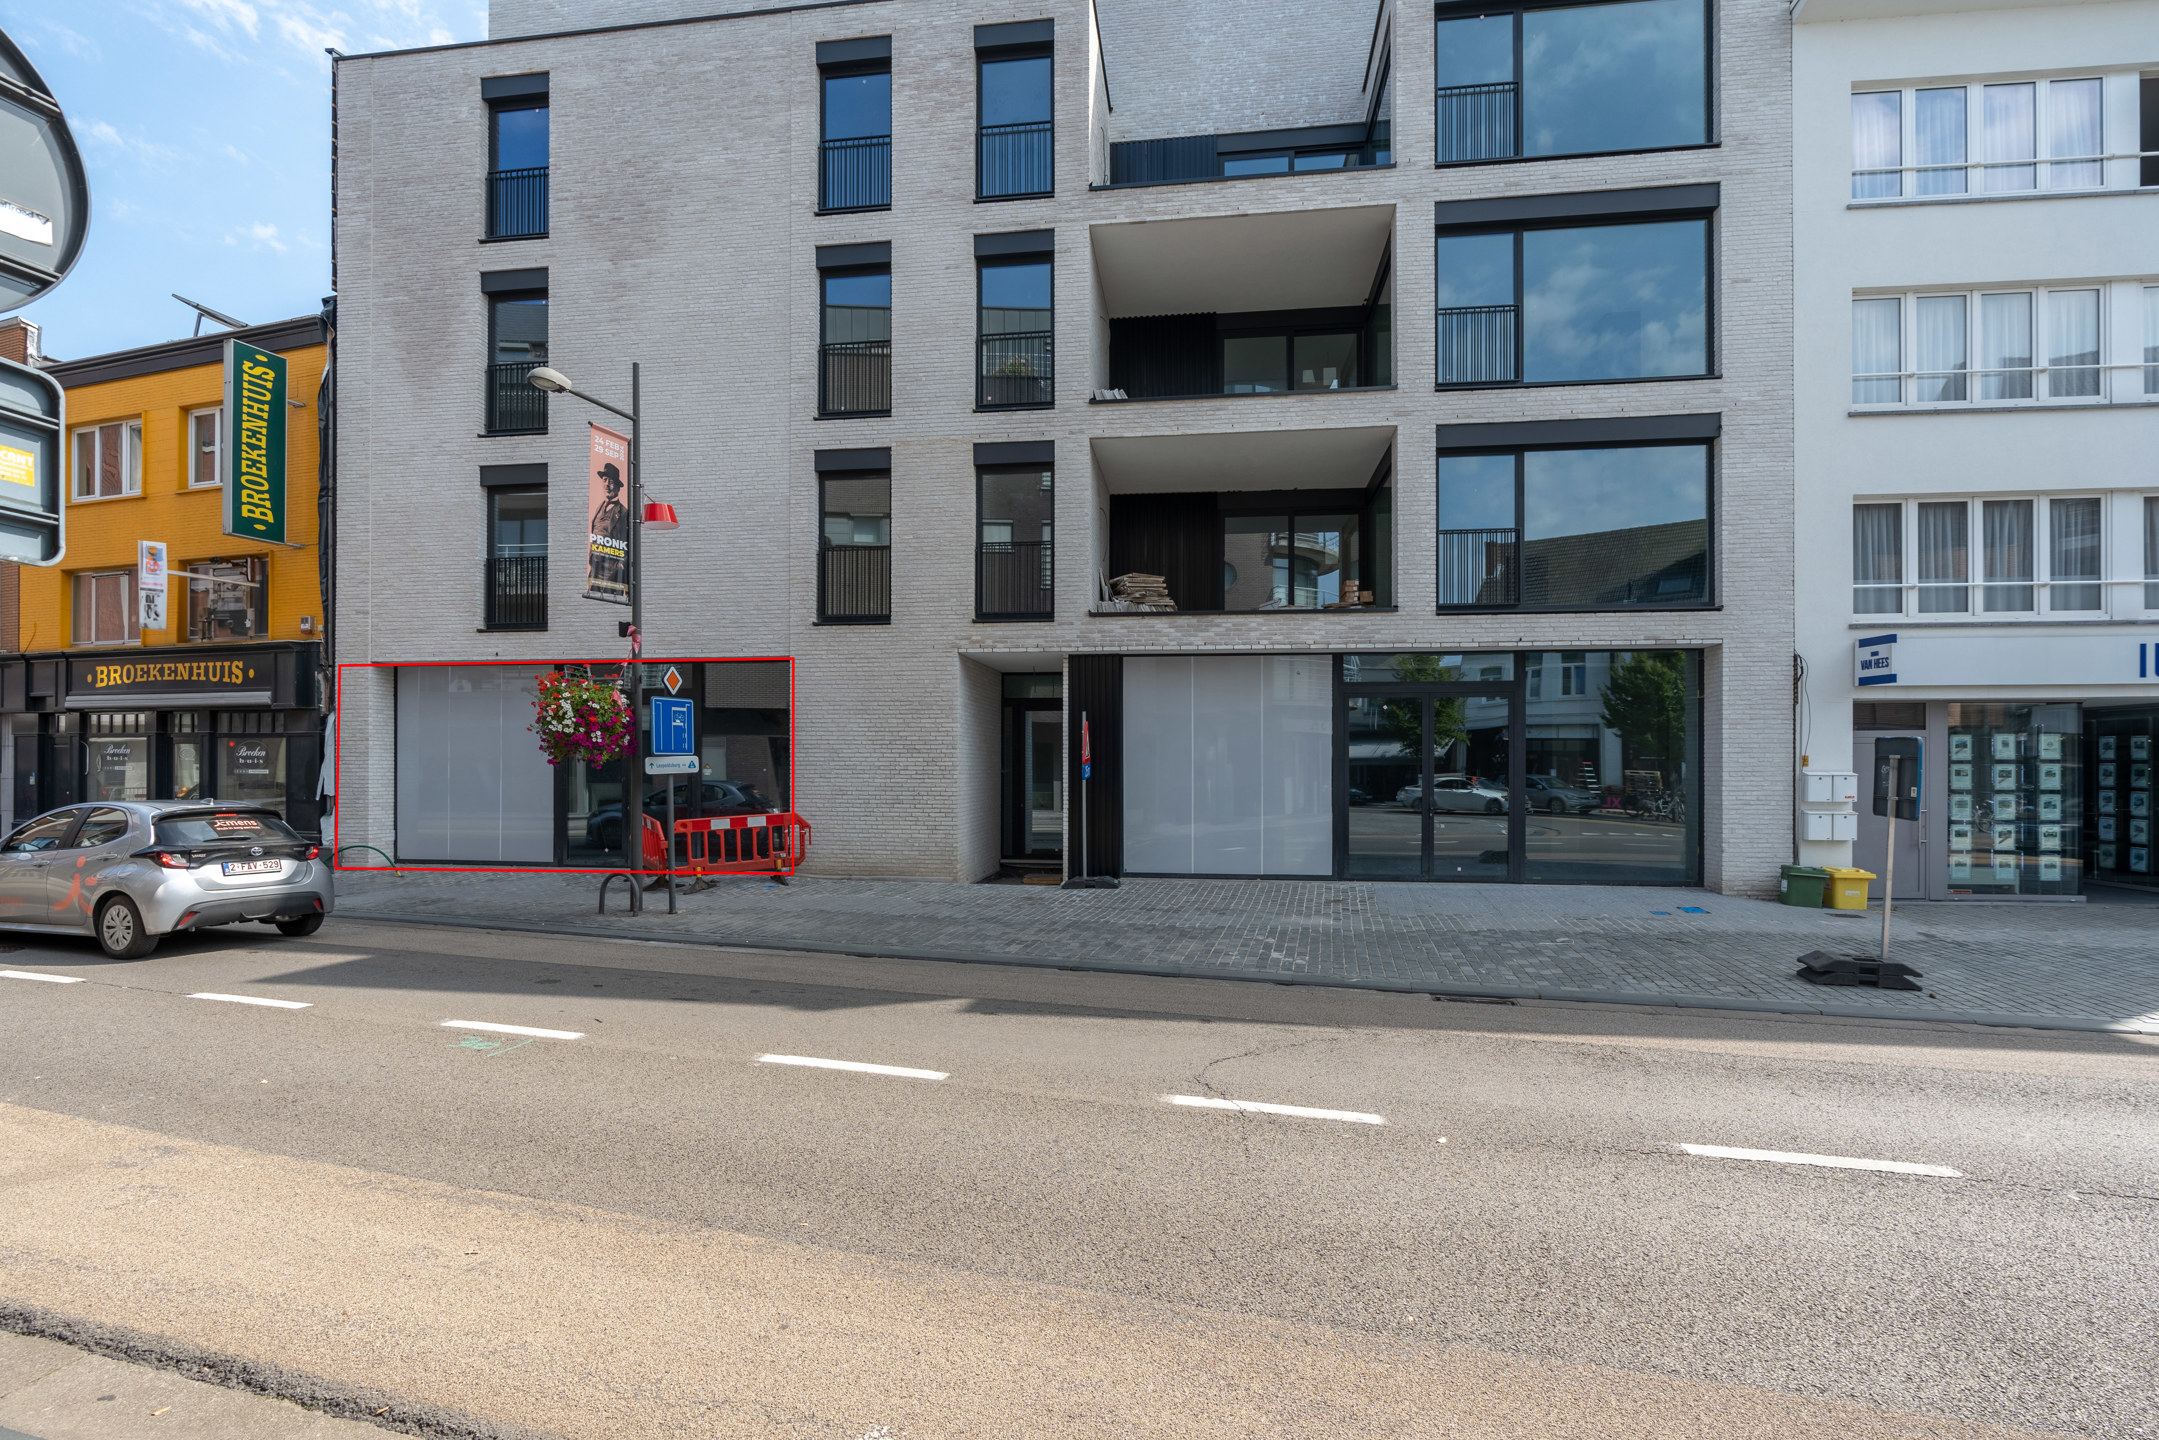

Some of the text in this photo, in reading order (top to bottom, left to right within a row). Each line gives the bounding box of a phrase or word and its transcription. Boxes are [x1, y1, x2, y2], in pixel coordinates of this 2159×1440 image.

[241, 360, 275, 523] BROEKENHUIS
[594, 435, 620, 450] 24 FEB
[594, 444, 619, 458] 29 SEP
[590, 533, 628, 550] PRONK
[591, 544, 625, 557] KAMERS
[1861, 656, 1889, 670] VAN HEES
[95, 660, 244, 688] BROEKENHUIS
[229, 860, 280, 872] 2-FAV-529
